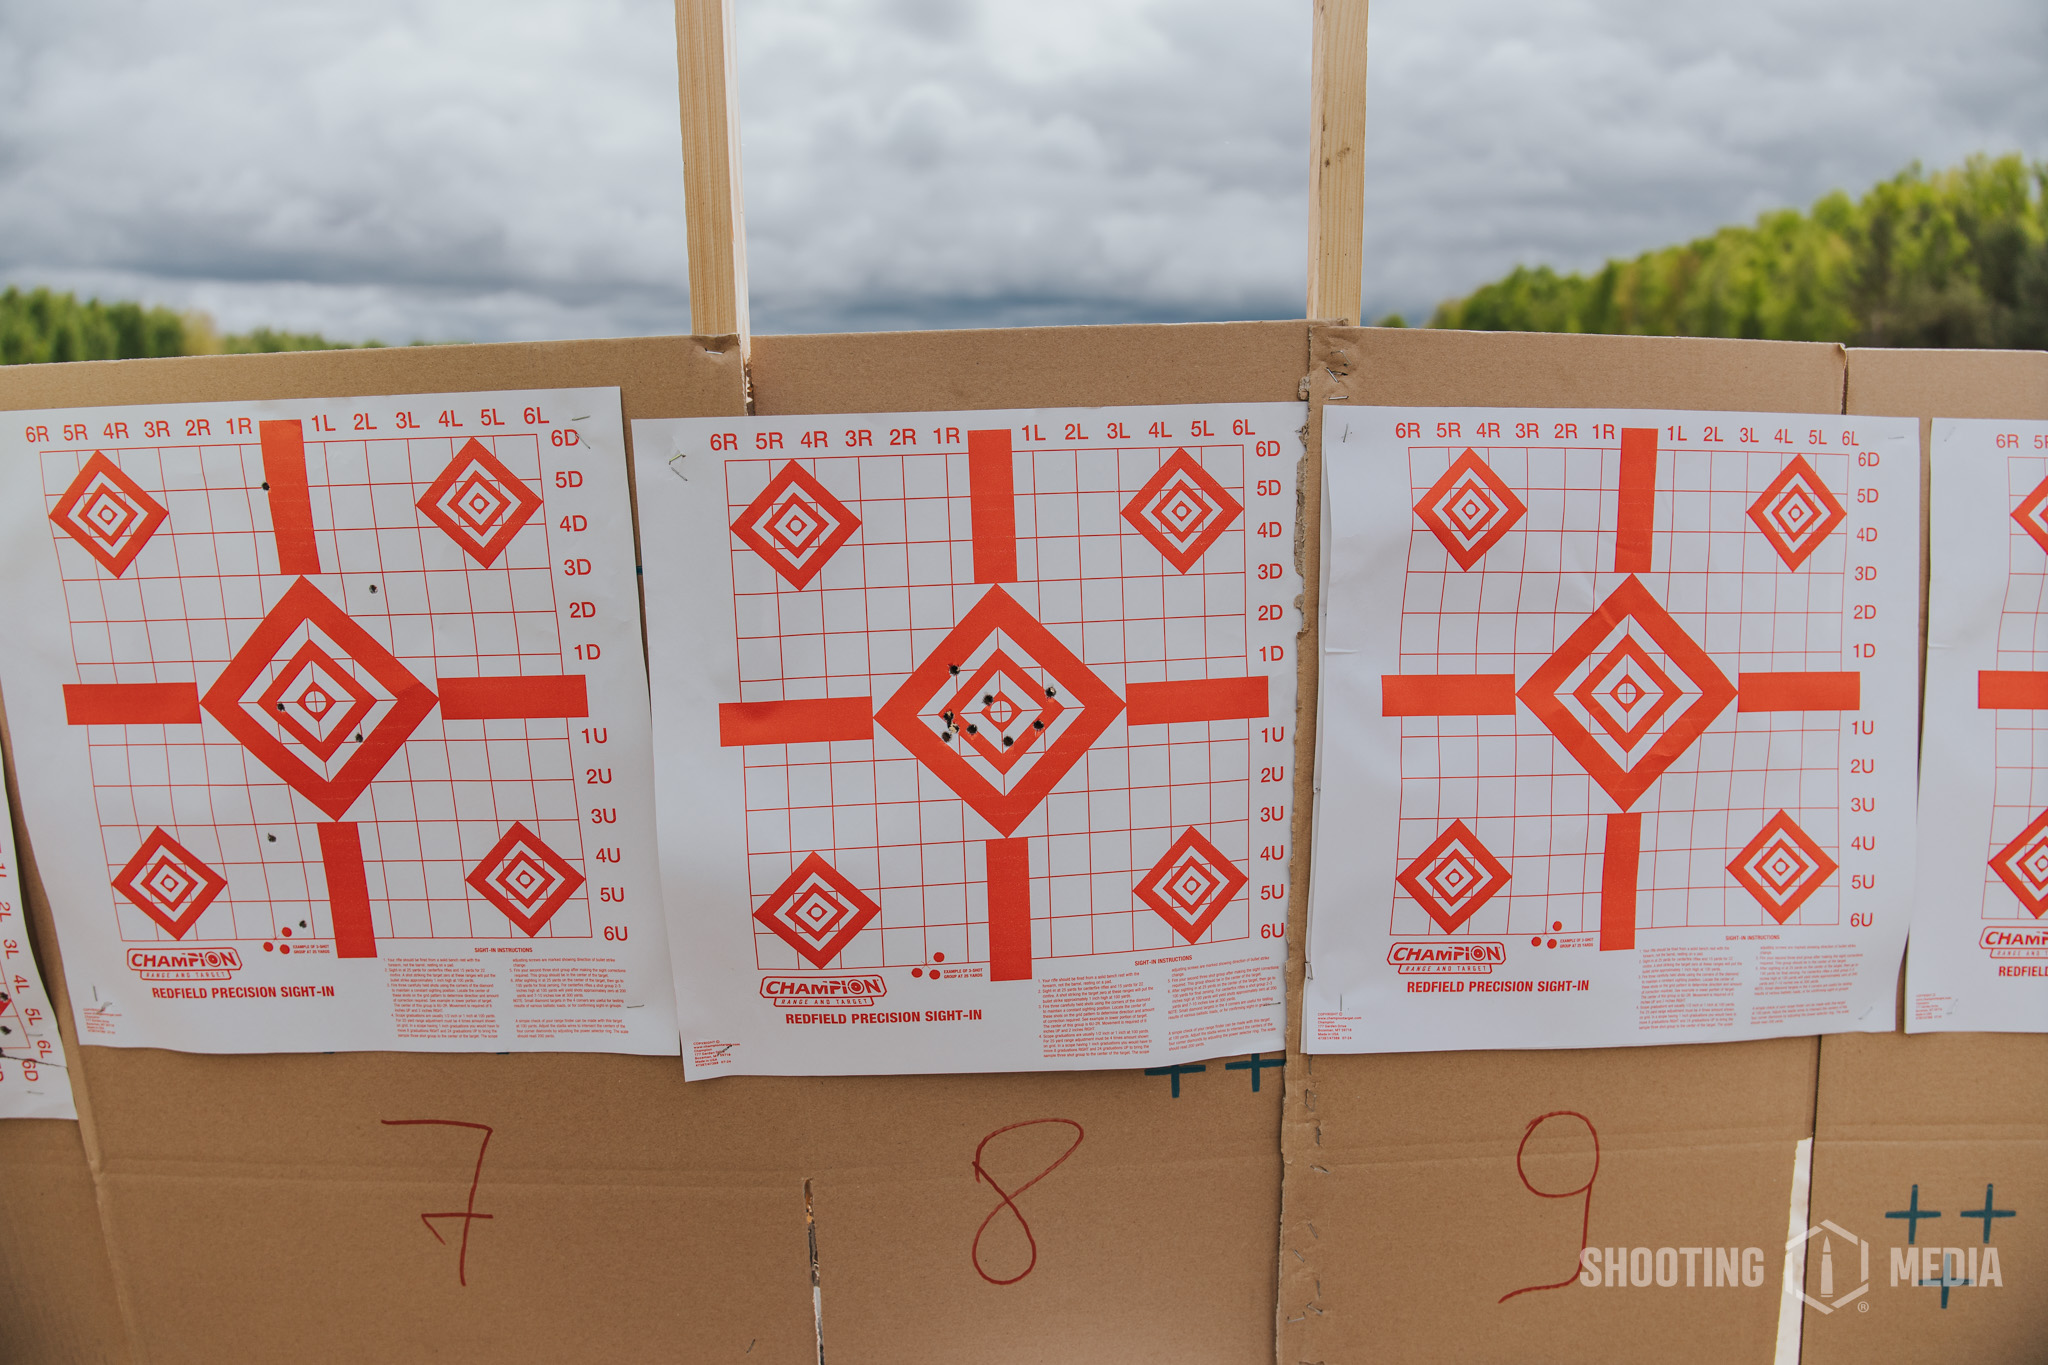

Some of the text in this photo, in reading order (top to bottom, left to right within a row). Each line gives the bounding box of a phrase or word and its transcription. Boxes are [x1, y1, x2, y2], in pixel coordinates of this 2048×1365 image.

[26, 407, 549, 443] 6R 5R 4R 3R 2R 1R 1L 2L 3L 4L 5L 6L
[551, 429, 579, 447] 6D
[710, 419, 1255, 451] 6R 5R 4R 3R 2R 1R 1L 2L 3L 4L 5L 6L
[1396, 422, 1859, 446] 6R 5R 4R 3R 2R 1R 1L 2L 3L 4L 5L 6L
[1997, 434, 2048, 449] 6R 5
[1256, 441, 1280, 457] 6D
[1859, 452, 1880, 467] 6D
[556, 471, 583, 488] 5D
[1257, 480, 1281, 496] 5D
[1857, 488, 1879, 503] 5D
[560, 515, 587, 532] 4D
[1257, 522, 1282, 538] 4D
[1857, 527, 1878, 542] 4D
[564, 559, 591, 576] 3D
[1258, 563, 1283, 580] 3D
[1856, 566, 1877, 581] 3D
[569, 602, 596, 618] 2D
[1258, 605, 1283, 621] 2D
[1854, 605, 1876, 619] 2D
[574, 644, 600, 660] 1D
[1259, 646, 1284, 662] 1D
[1854, 643, 1875, 658] 1D
[1261, 726, 1284, 743] 1U
[1852, 720, 1874, 735] 1U
[582, 728, 607, 744] 1U
[1851, 759, 1874, 773] 2U
[586, 768, 612, 784] 2U
[1261, 766, 1283, 783] 2U
[1851, 798, 1874, 812] 3U
[591, 808, 616, 824] 3U
[1260, 806, 1283, 822] 3U
[1852, 836, 1875, 850] 4U
[596, 848, 620, 863] 4U
[1260, 845, 1284, 861] 4U
[1853, 875, 1874, 889] 5U
[601, 887, 624, 902] 5U
[1261, 884, 1284, 900] 5U
[1852, 913, 1873, 927] 6U
[604, 926, 628, 941] 6U
[1261, 922, 1284, 939] 6U
[1158, 955, 1193, 963] INSTRUCTIONS
[152, 985, 335, 999] REDFIELD PRECISION SIGHT-IN
[1407, 980, 1589, 993] REDFIELD PRECISION SIGHT-IN
[3, 939, 19, 959] 3L
[14, 975, 30, 994] 4L
[25, 1007, 42, 1026] 5L
[37, 1039, 53, 1059] 6L
[785, 1009, 982, 1024] REDFIELD PRECISION SIGHT-IN
[381, 1118, 493, 1286] 7
[972, 1118, 1084, 1285] 8
[1497, 1111, 1600, 1304] 9
